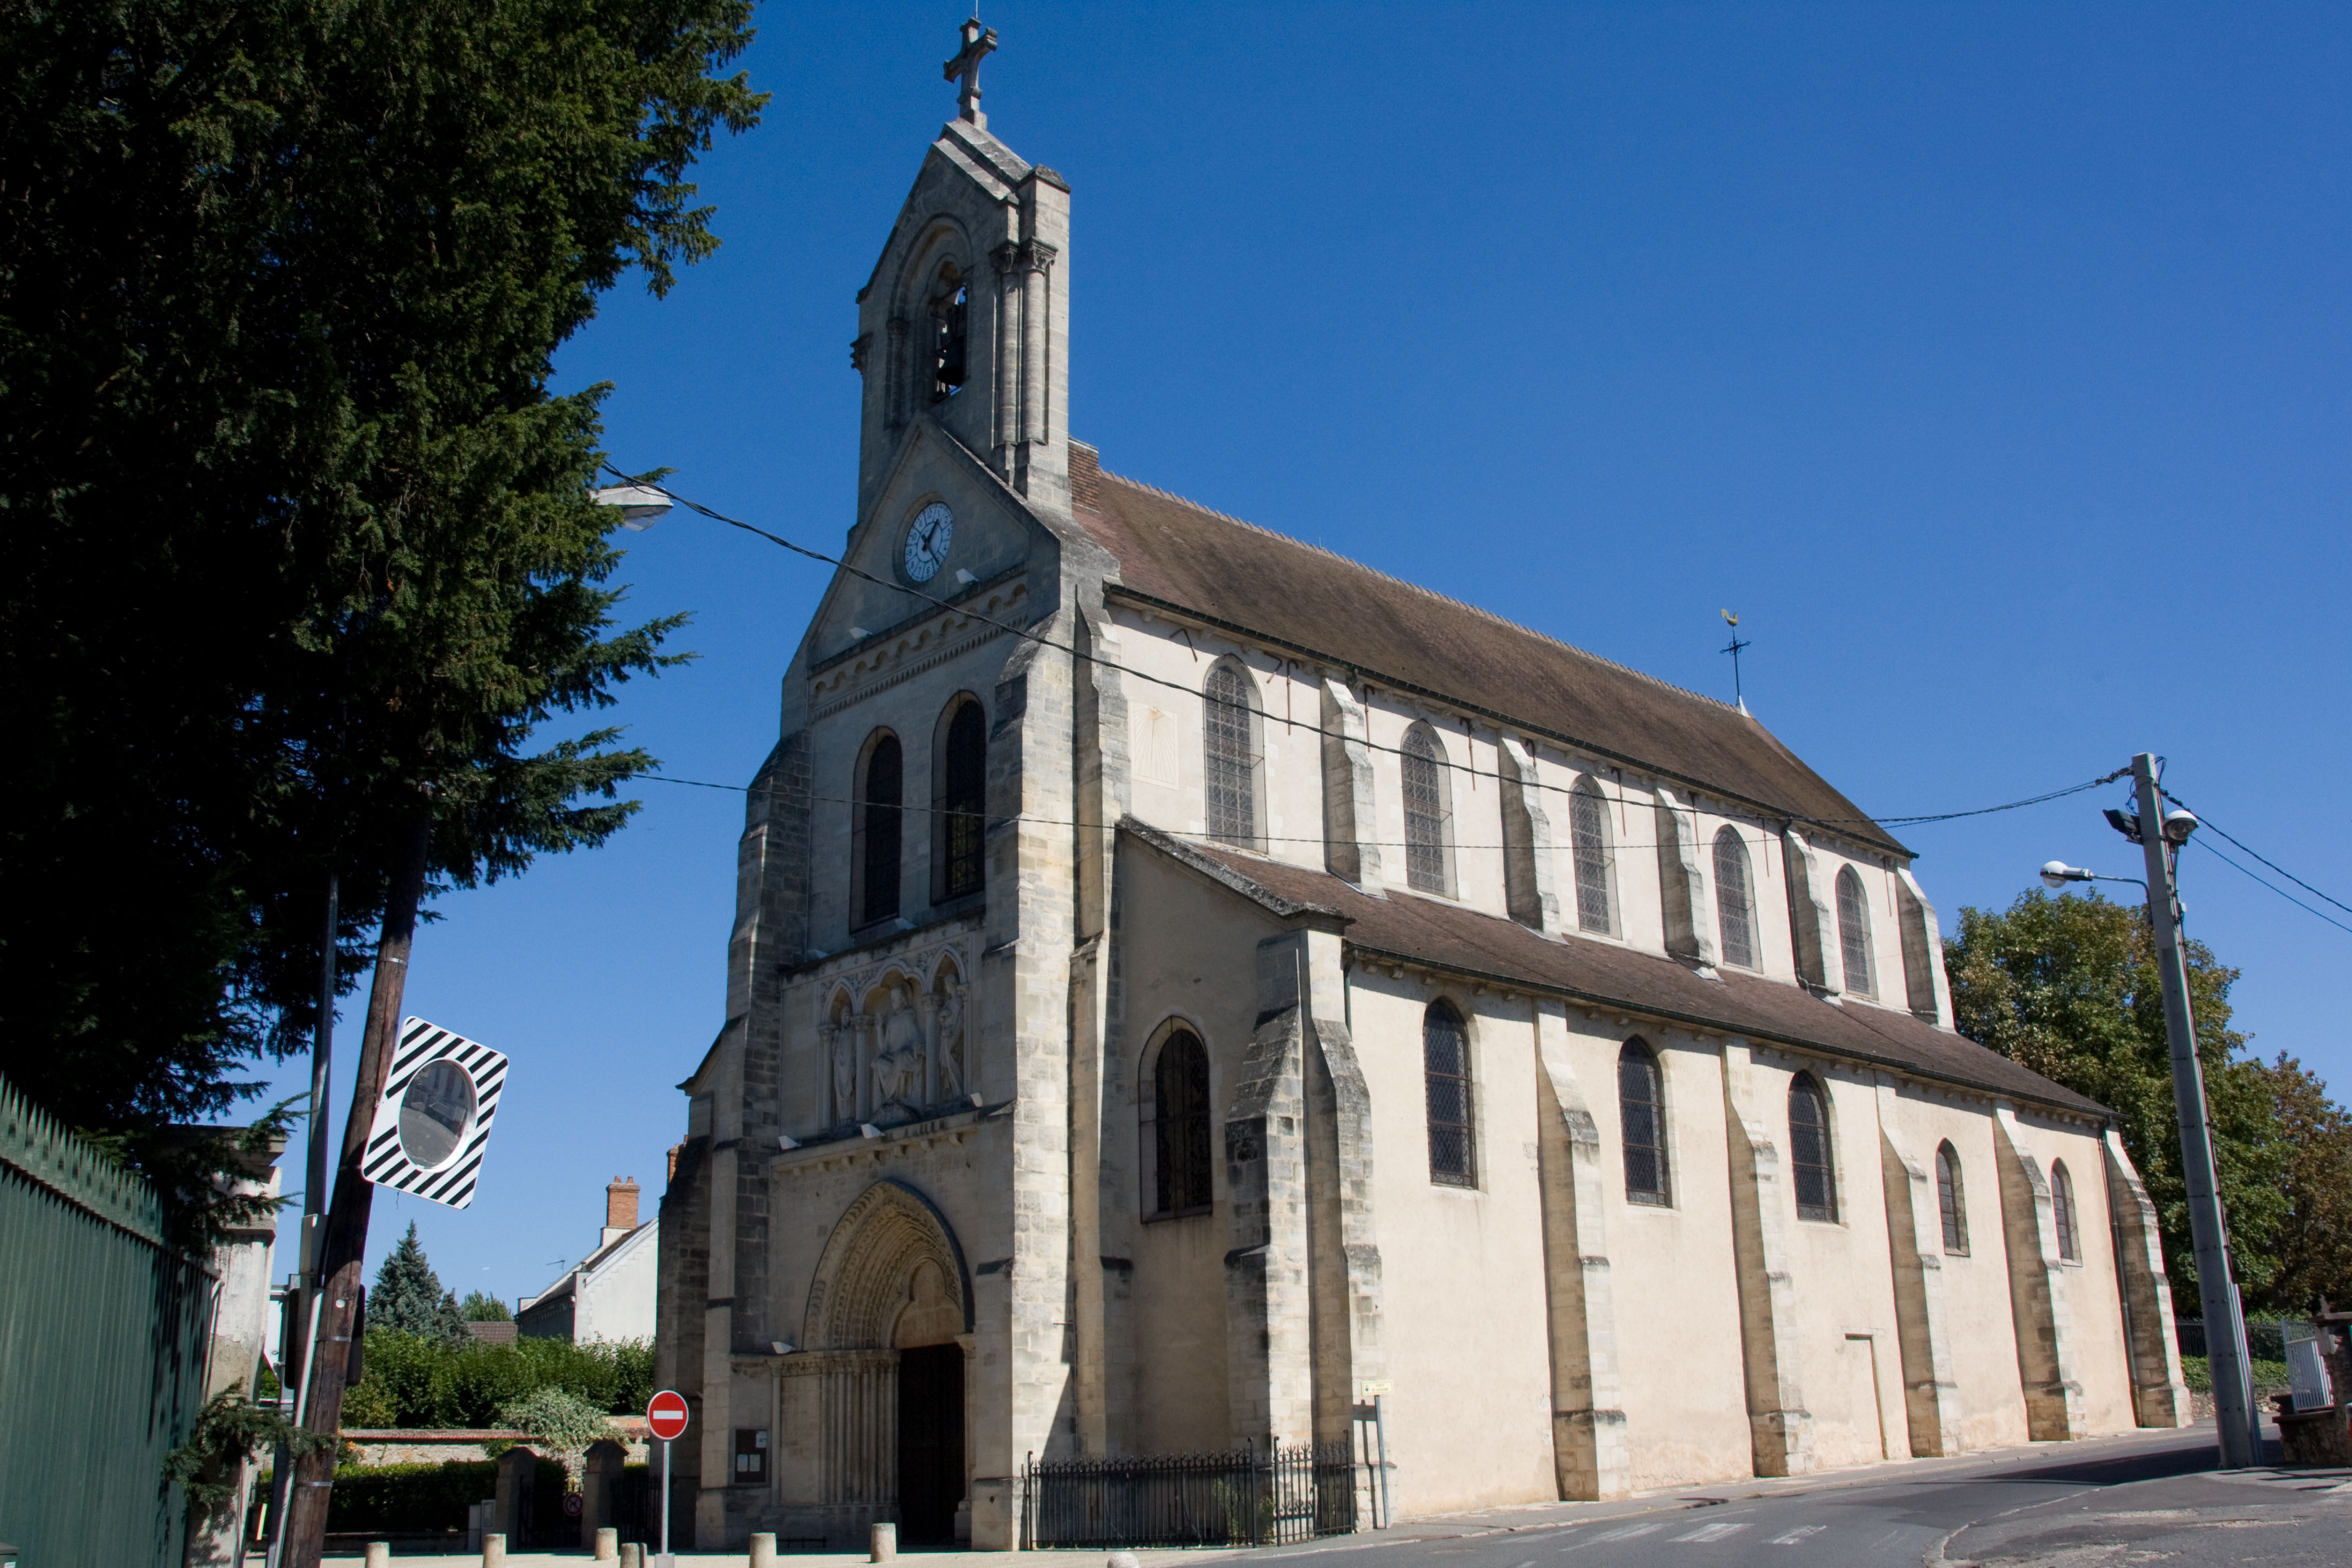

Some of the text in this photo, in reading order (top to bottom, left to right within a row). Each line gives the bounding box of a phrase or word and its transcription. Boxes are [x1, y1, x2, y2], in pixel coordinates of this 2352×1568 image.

[927, 510, 932, 519] 12
[944, 515, 948, 524] 2
[912, 532, 917, 541] 10
[947, 528, 950, 536] 3
[918, 566, 922, 575] 7
